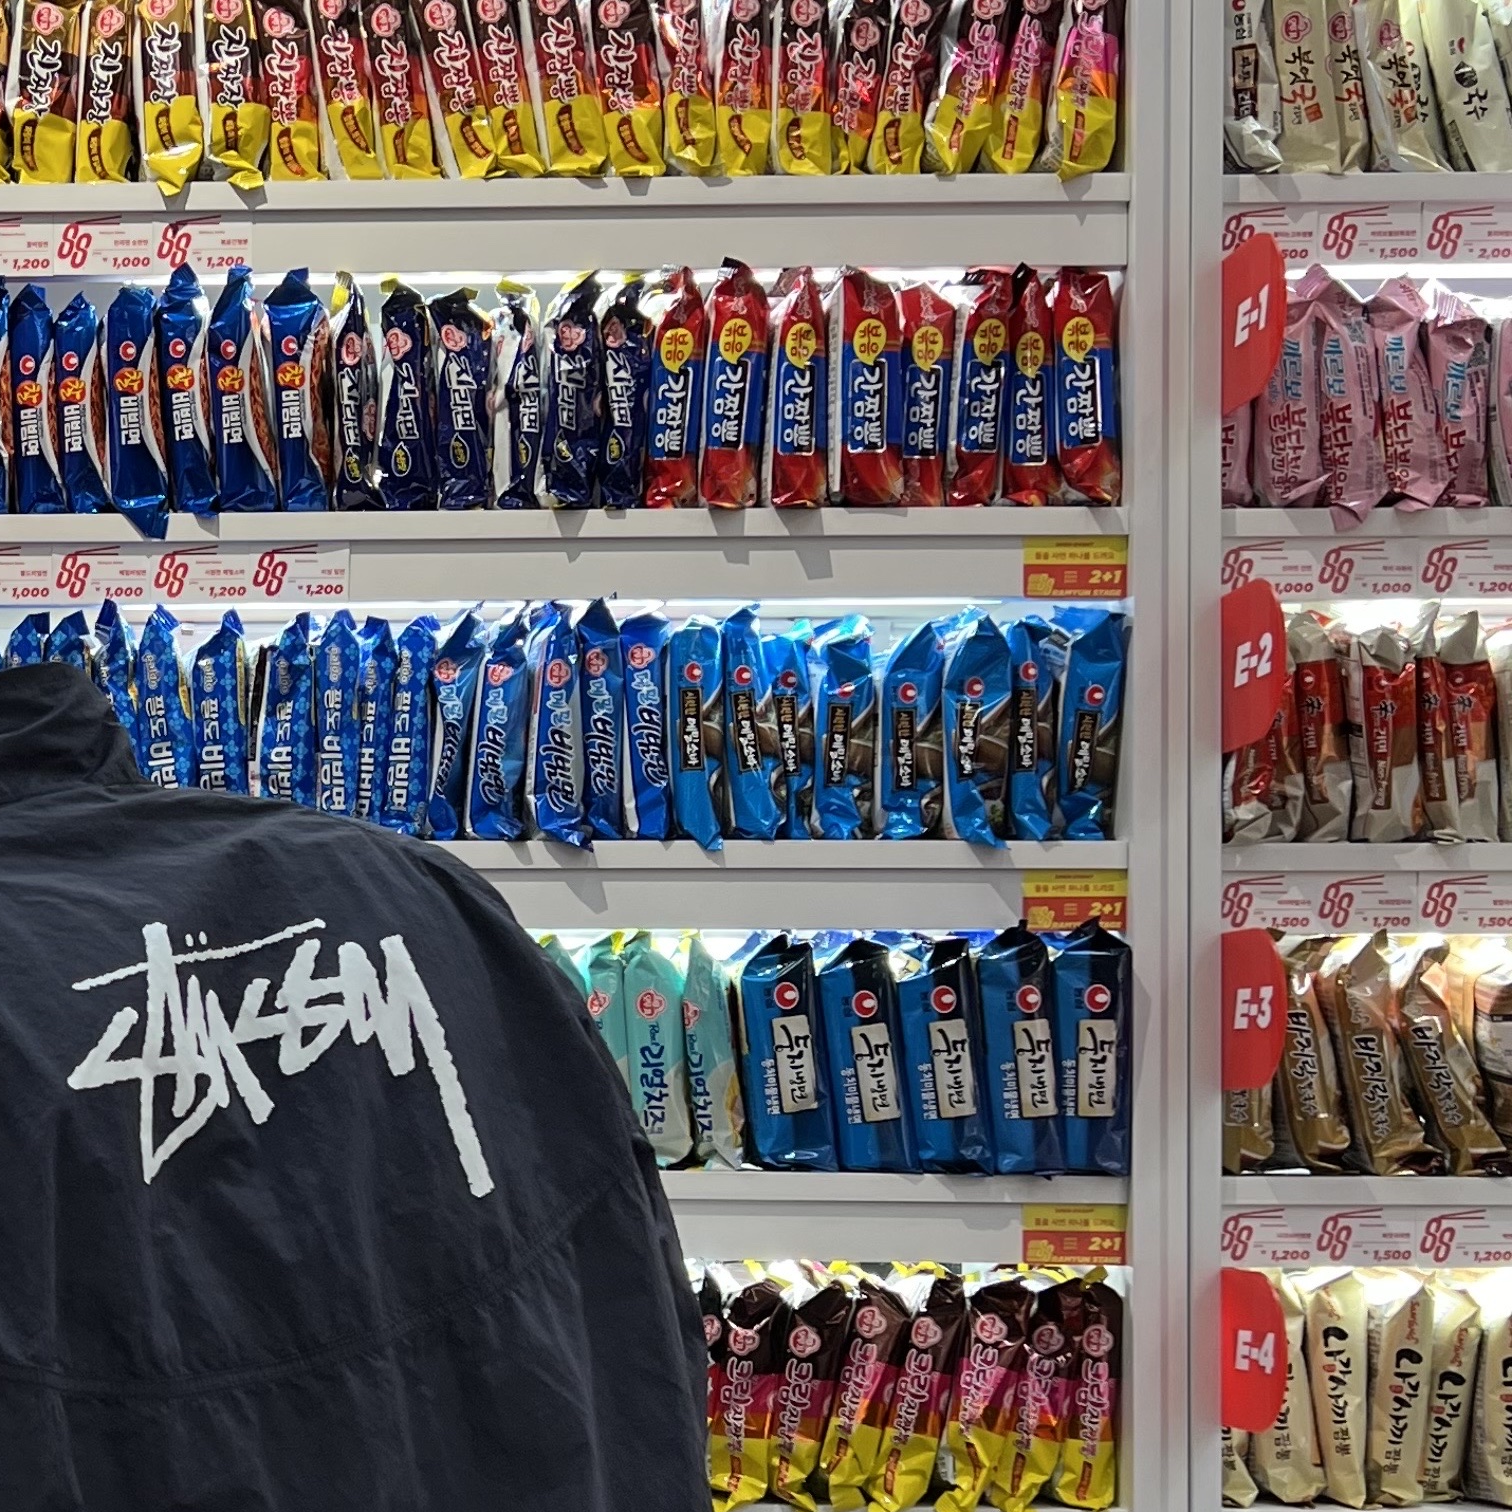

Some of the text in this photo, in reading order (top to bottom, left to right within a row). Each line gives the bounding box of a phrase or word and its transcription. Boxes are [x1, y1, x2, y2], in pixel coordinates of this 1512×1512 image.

[88, 39, 121, 127] 진짜장
[147, 21, 181, 104] 진짜장
[435, 30, 476, 112] 진짬뽕
[483, 24, 520, 108] 진짬뽕
[603, 30, 639, 113] 진짬뽕
[787, 28, 822, 114] 진짬뽕
[12, 258, 50, 270] 1,200
[112, 257, 151, 269] 1,000
[206, 256, 245, 268] 1,200
[1379, 247, 1418, 260] 1,500
[1234, 284, 1269, 347] E-1
[655, 376, 687, 452] 간짬뽕
[783, 371, 812, 446] 간짬뽕
[1065, 363, 1095, 439] 간짬뽕
[11, 587, 49, 599] 1,000
[104, 586, 143, 598] 1,000
[209, 585, 247, 597] 1,200
[305, 584, 344, 596] 1,200
[1089, 570, 1122, 584] 2+1
[1372, 583, 1411, 595] 1,000
[1234, 633, 1273, 687] E-2
[388, 690, 412, 811] 팔도 비빔면
[1089, 902, 1122, 916] 2+1
[1271, 916, 1310, 928] 1,500
[1373, 916, 1411, 927] 1,700
[1234, 986, 1273, 1030] E-3
[775, 1025, 810, 1101] 둥지냉면
[932, 1028, 967, 1108] 둥지냉면
[1078, 1026, 1114, 1107] 둥지냉면
[1089, 1237, 1122, 1251] 2+1
[1271, 1249, 1310, 1260] 1,200
[1374, 1249, 1411, 1260] 1,500
[1235, 1330, 1275, 1373] E-4
[1388, 1348, 1422, 1447] 나가사끼
